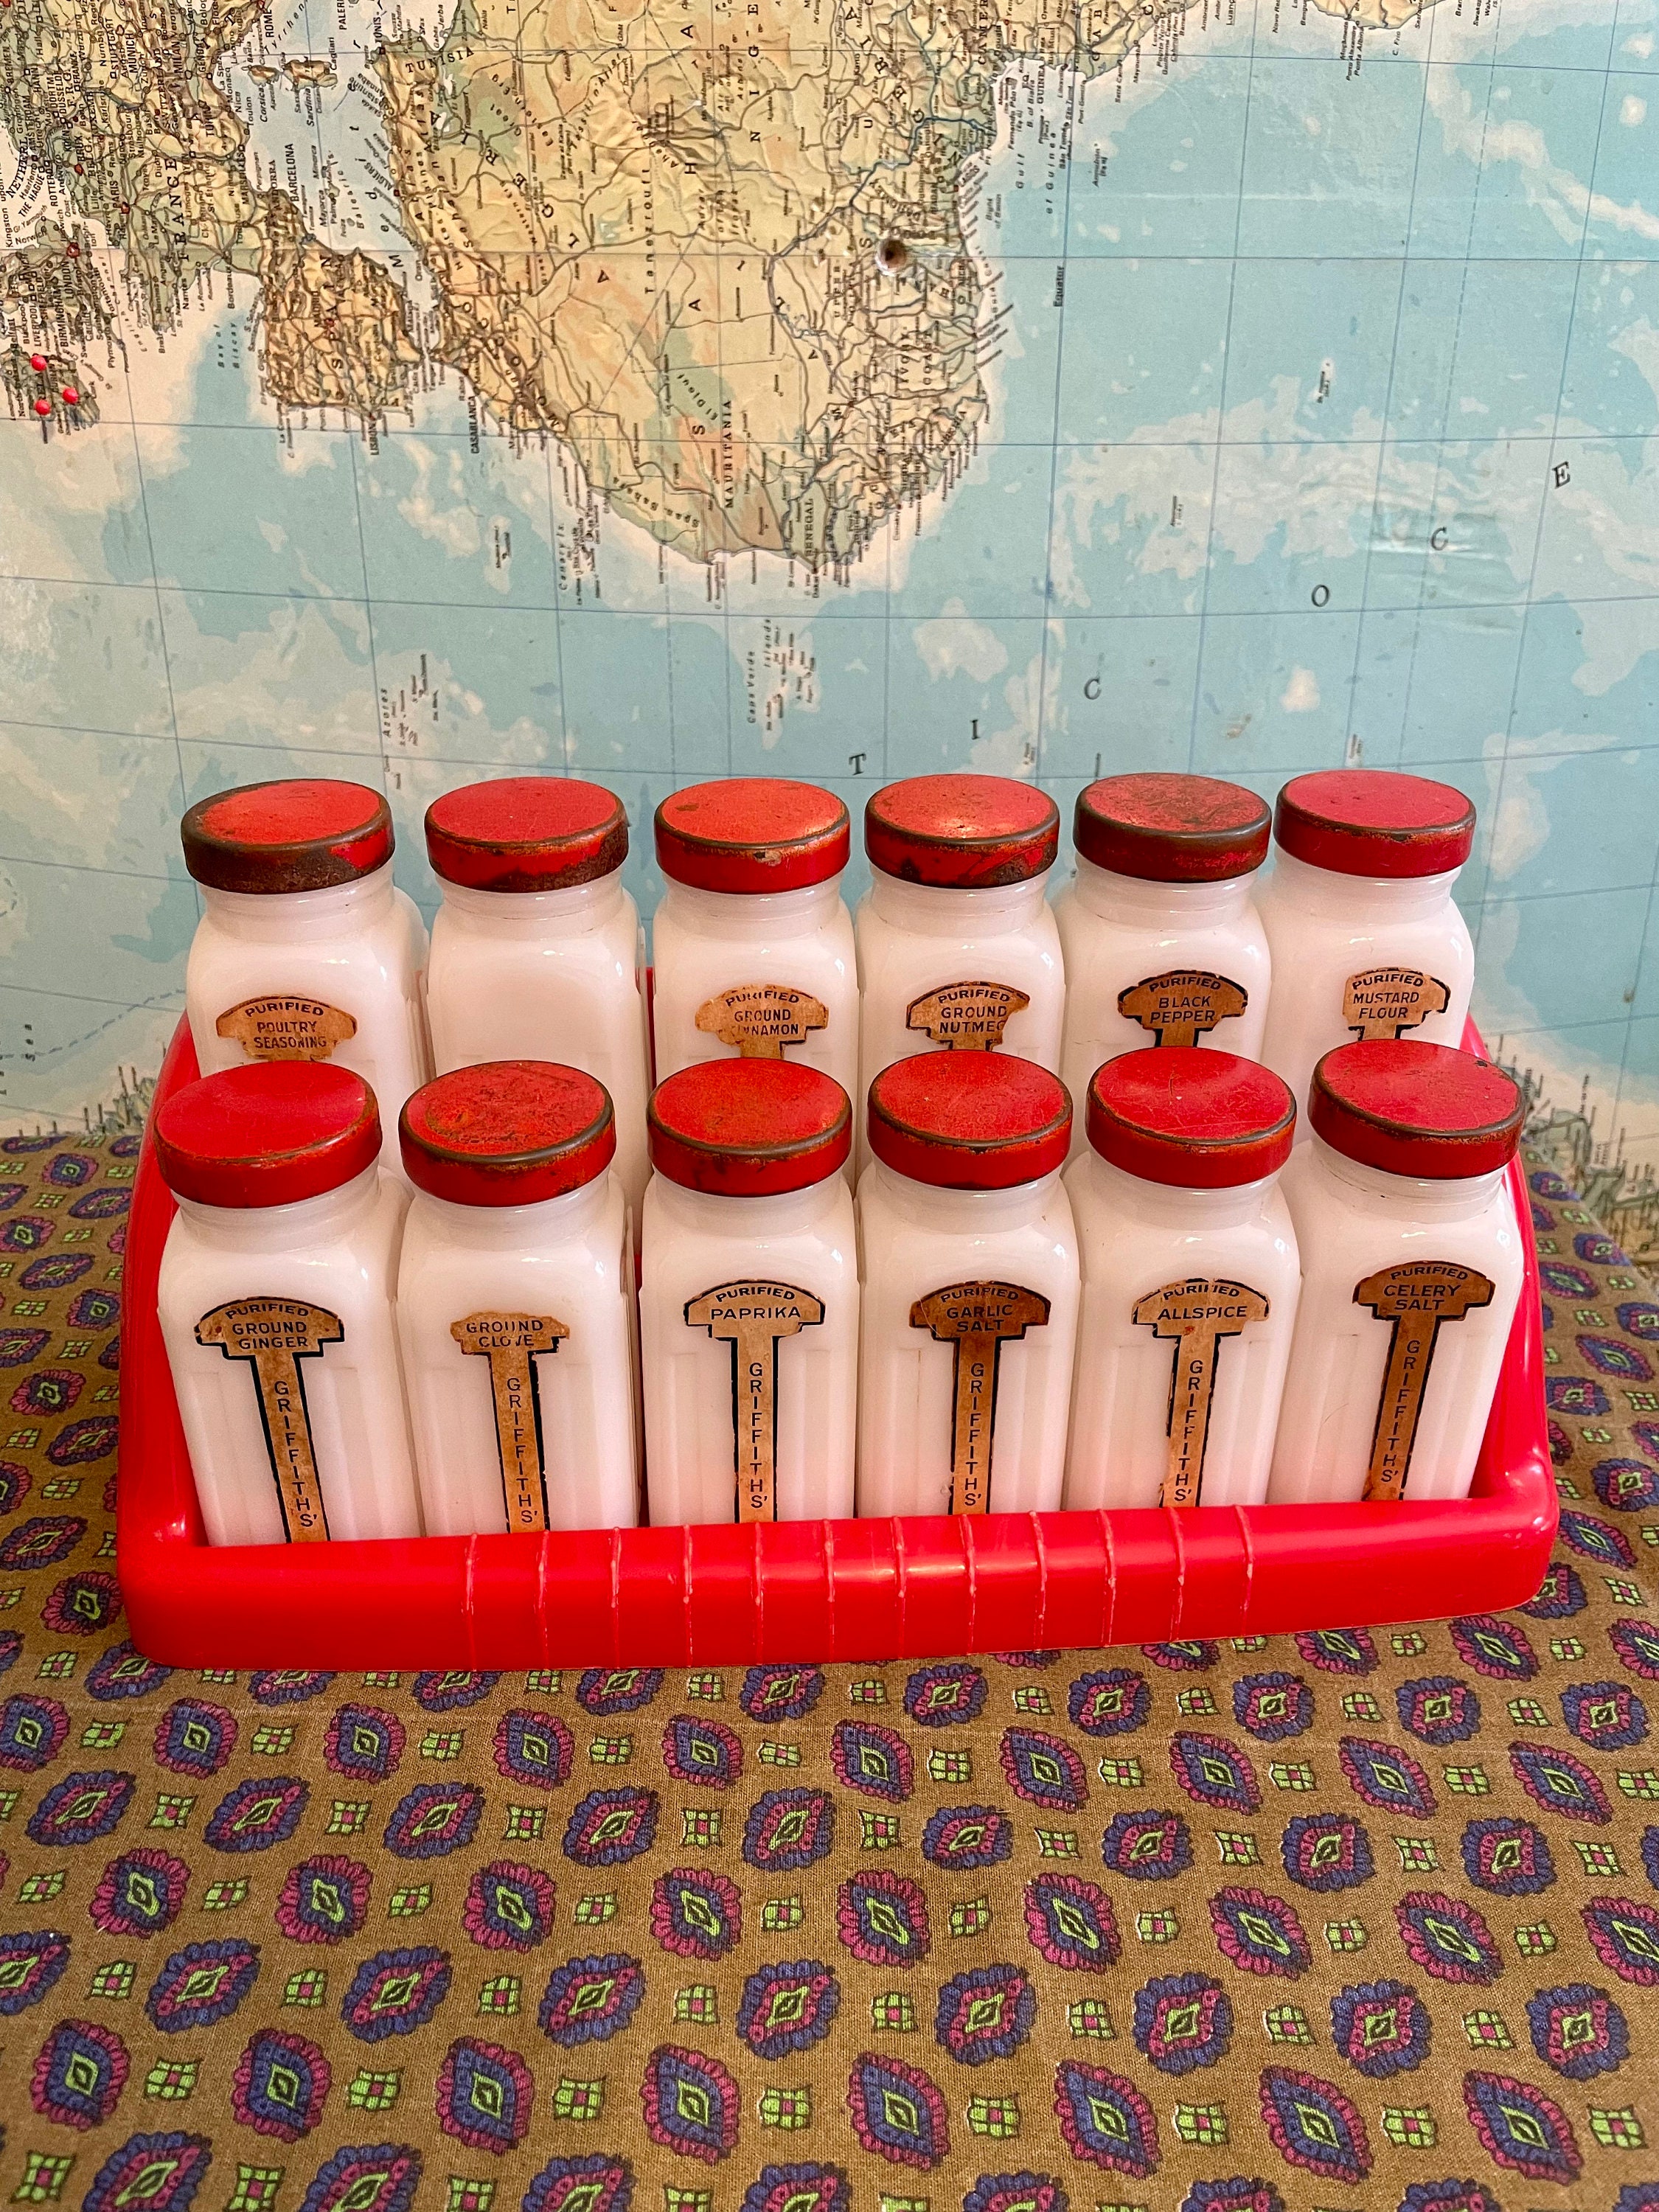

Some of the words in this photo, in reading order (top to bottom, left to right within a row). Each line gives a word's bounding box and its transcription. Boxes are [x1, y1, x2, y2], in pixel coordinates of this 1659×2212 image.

[265, 10, 274, 38] ROME
[105, 18, 119, 69] STUTTGART
[126, 33, 138, 73] MUNICH
[171, 41, 183, 73] MILAN
[328, 37, 337, 70] Cagliari
[1036, 61, 1046, 102] GUINEA
[245, 97, 254, 127] Toulon
[257, 88, 268, 122] Corsica
[304, 88, 315, 126] Sardinia
[23, 95, 37, 150] AMSTERDAM
[284, 144, 300, 202] BARCELONA
[18, 204, 32, 218] THE
[26, 170, 45, 202] HAGUE
[110, 181, 119, 208] PARIS
[165, 157, 189, 261] FRANCE
[1, 208, 13, 247] Kingston
[640, 169, 655, 295] Tanezrouft
[61, 261, 74, 299] LONDON
[1053, 266, 1064, 307] Equator
[52, 285, 69, 347] BIRMINGHAM
[467, 396, 480, 454] CASABLANCA
[723, 400, 733, 509] MAURITANIA
[804, 498, 813, 557] SENEGAL
[380, 688, 391, 738] Azores
[1149, 977, 1221, 992] PURIFIED
[1352, 974, 1424, 990] PURIFIED
[726, 990, 799, 1006] PURIFIED
[938, 990, 1010, 1004] PURIFIED
[1159, 996, 1211, 1009] BLACK
[1353, 992, 1419, 1004] MUSTARD
[245, 1002, 324, 1017] PURIFIED
[734, 1009, 791, 1022] GROUND
[941, 1006, 1007, 1018] GROUND
[1150, 1010, 1215, 1023] PEPPER
[1359, 1007, 1408, 1019] FLOUR
[257, 1021, 317, 1032] POULTRY
[254, 1037, 327, 1048] SEASONING
[1391, 1267, 1468, 1280] PURIFIED
[716, 1287, 796, 1302] PURIFIED
[941, 1287, 1019, 1303] PURIFIED
[1383, 1284, 1461, 1296] CELERY
[226, 1304, 309, 1320] PURIFIED
[947, 1304, 1013, 1318] GARLIC
[1394, 1299, 1444, 1310] SALT
[711, 1307, 801, 1320] PAPRIKA
[1158, 1306, 1248, 1320] ALLSPICE
[232, 1322, 307, 1335] GROUND
[466, 1320, 543, 1333] GROUND
[957, 1319, 1004, 1332] SALT
[239, 1337, 307, 1349] GINGER
